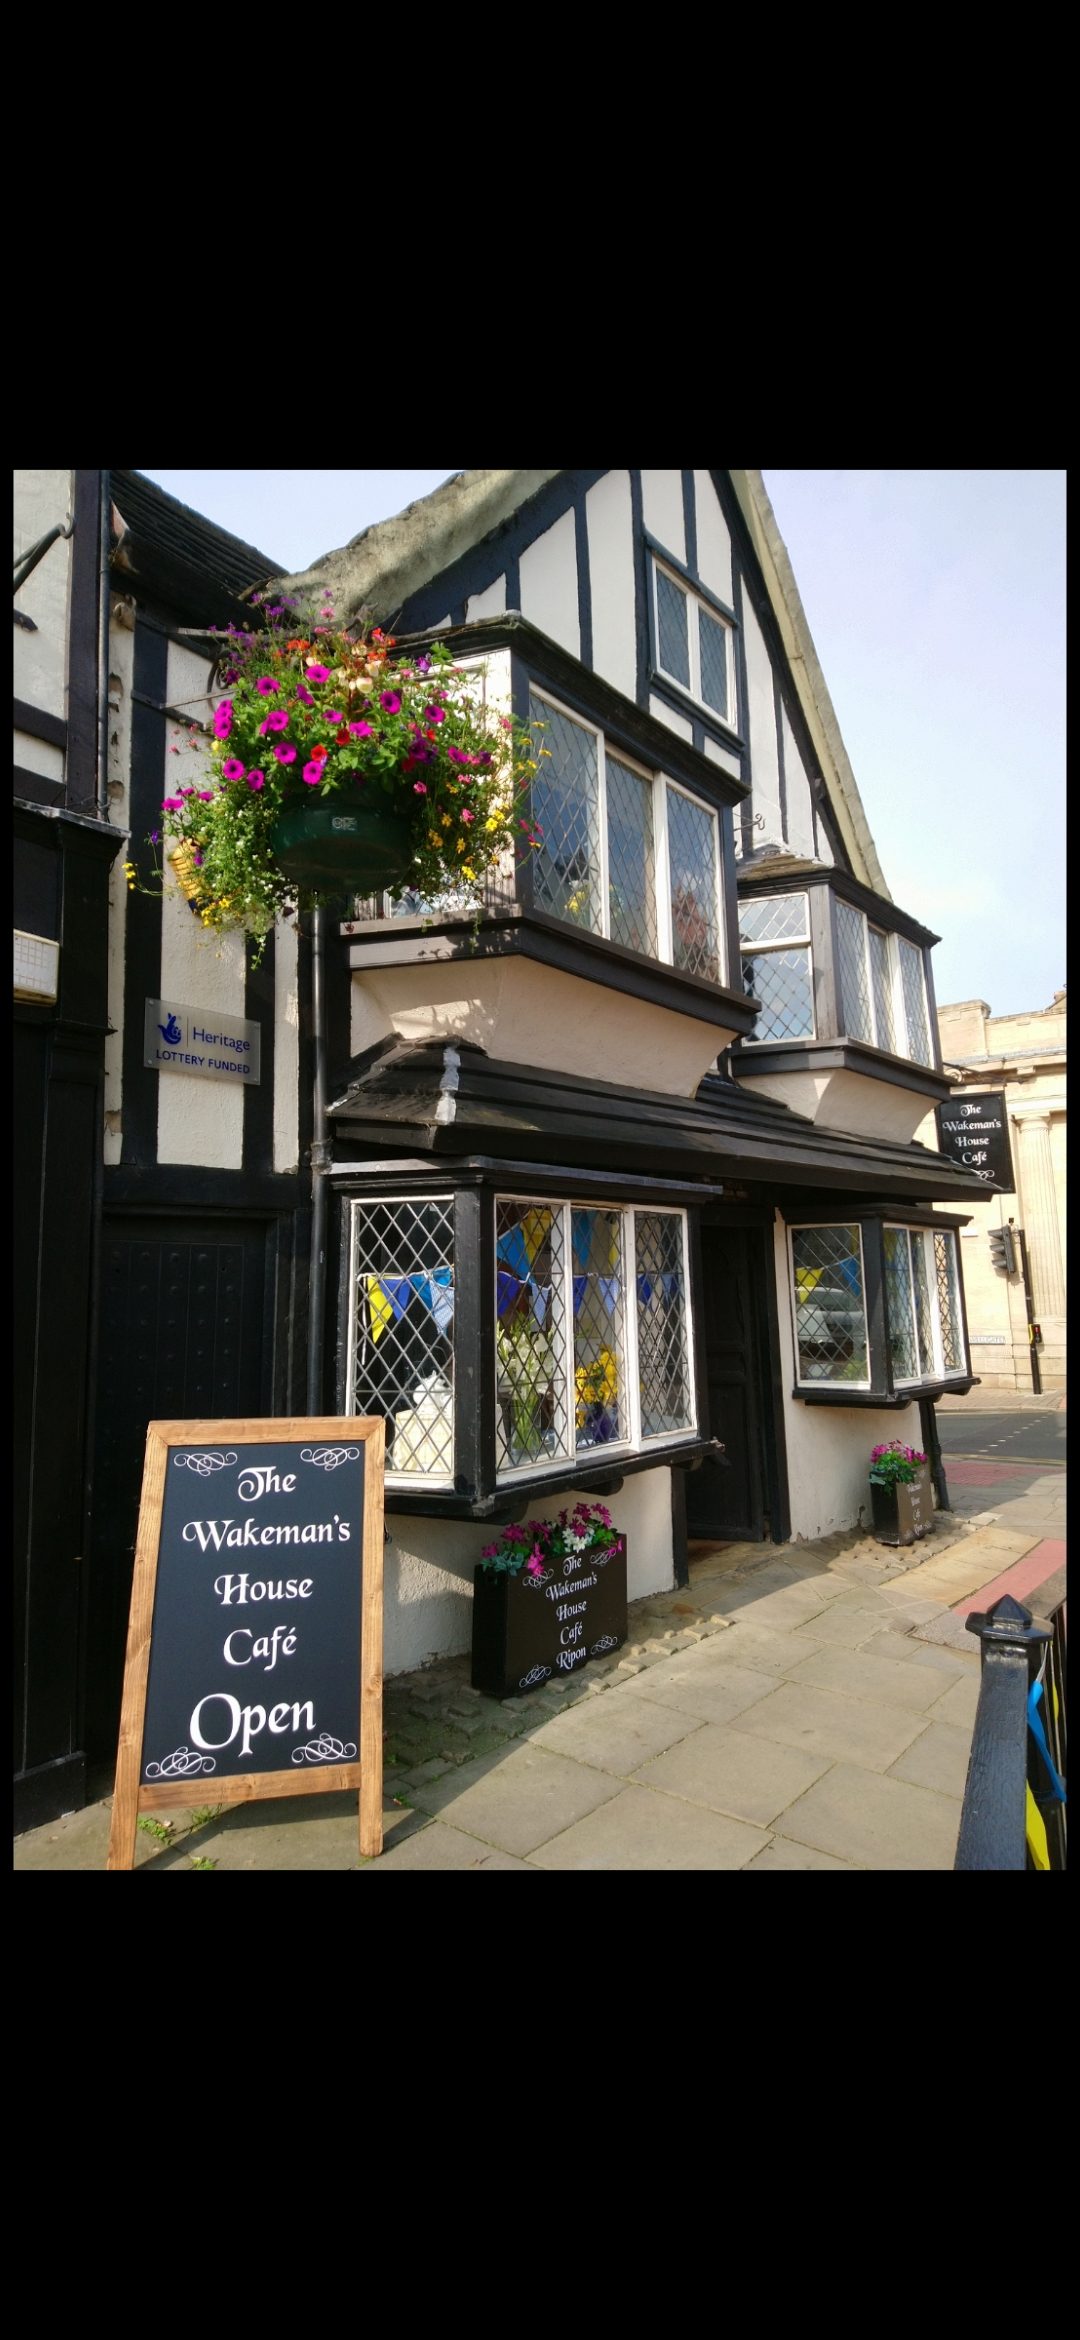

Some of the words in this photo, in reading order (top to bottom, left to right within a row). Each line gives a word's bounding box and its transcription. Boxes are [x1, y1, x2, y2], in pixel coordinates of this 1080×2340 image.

[193, 1027, 250, 1053] Heritage
[156, 1049, 205, 1067] LOTTERY
[208, 1059, 250, 1074] FUNDED
[960, 1104, 982, 1117] The
[942, 1118, 1002, 1132] Wakeman's
[955, 1136, 990, 1147] House
[962, 1151, 987, 1165] Café
[237, 1466, 297, 1501] The
[182, 1514, 351, 1552] Wakeman's
[563, 1555, 582, 1576] The
[214, 1573, 314, 1605] House
[545, 1571, 598, 1601] Wakeman's
[556, 1600, 587, 1622] House
[560, 1621, 583, 1645] Café
[223, 1625, 298, 1671] Café
[556, 1646, 587, 1670] Ripon
[189, 1693, 316, 1758] Open
